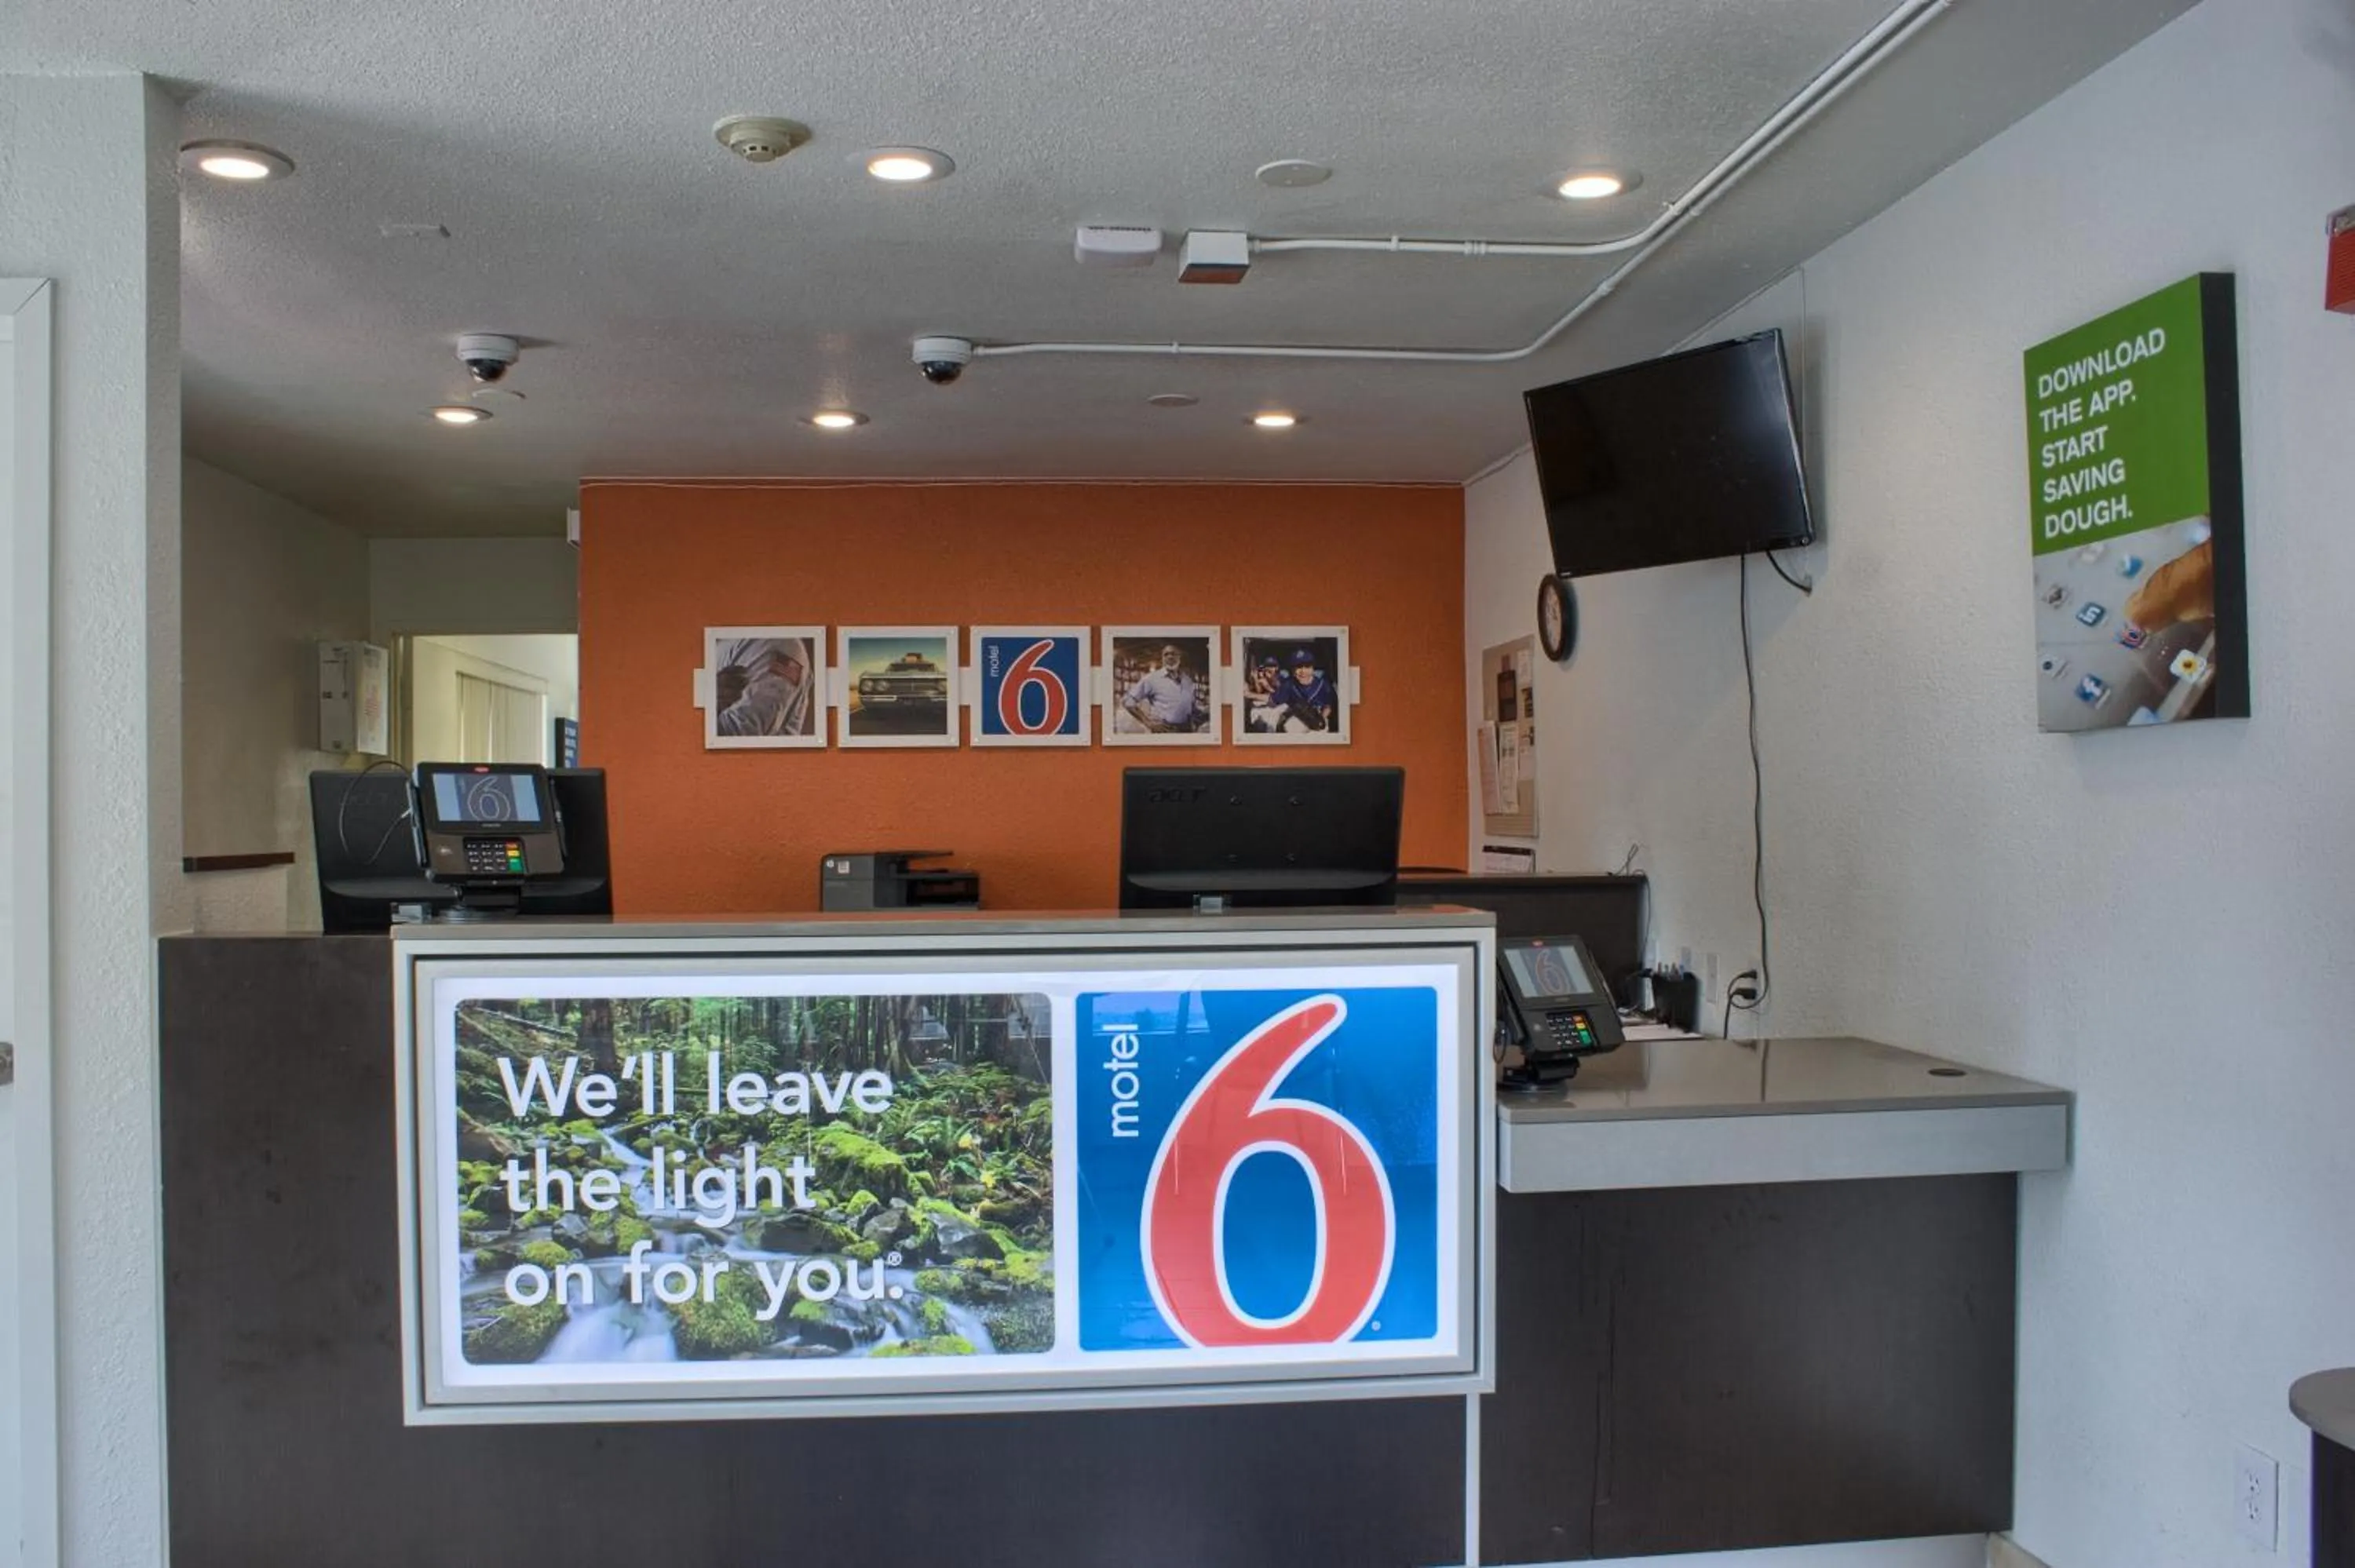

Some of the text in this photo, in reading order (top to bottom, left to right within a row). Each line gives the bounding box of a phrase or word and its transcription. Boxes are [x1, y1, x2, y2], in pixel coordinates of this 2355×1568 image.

[2039, 327, 2166, 399] DOWNLOAD
[2039, 378, 2137, 432] THE APP.
[2042, 425, 2109, 468] START
[2043, 458, 2126, 503] SAVING
[2045, 494, 2134, 539] DOUGH.
[988, 638, 1068, 736] motel 6
[466, 775, 511, 822] 6
[707, 1051, 893, 1114] leave
[499, 1145, 816, 1228] the light
[1102, 993, 1397, 1348] motel 6
[504, 1262, 595, 1306] on
[623, 1239, 730, 1305] for
